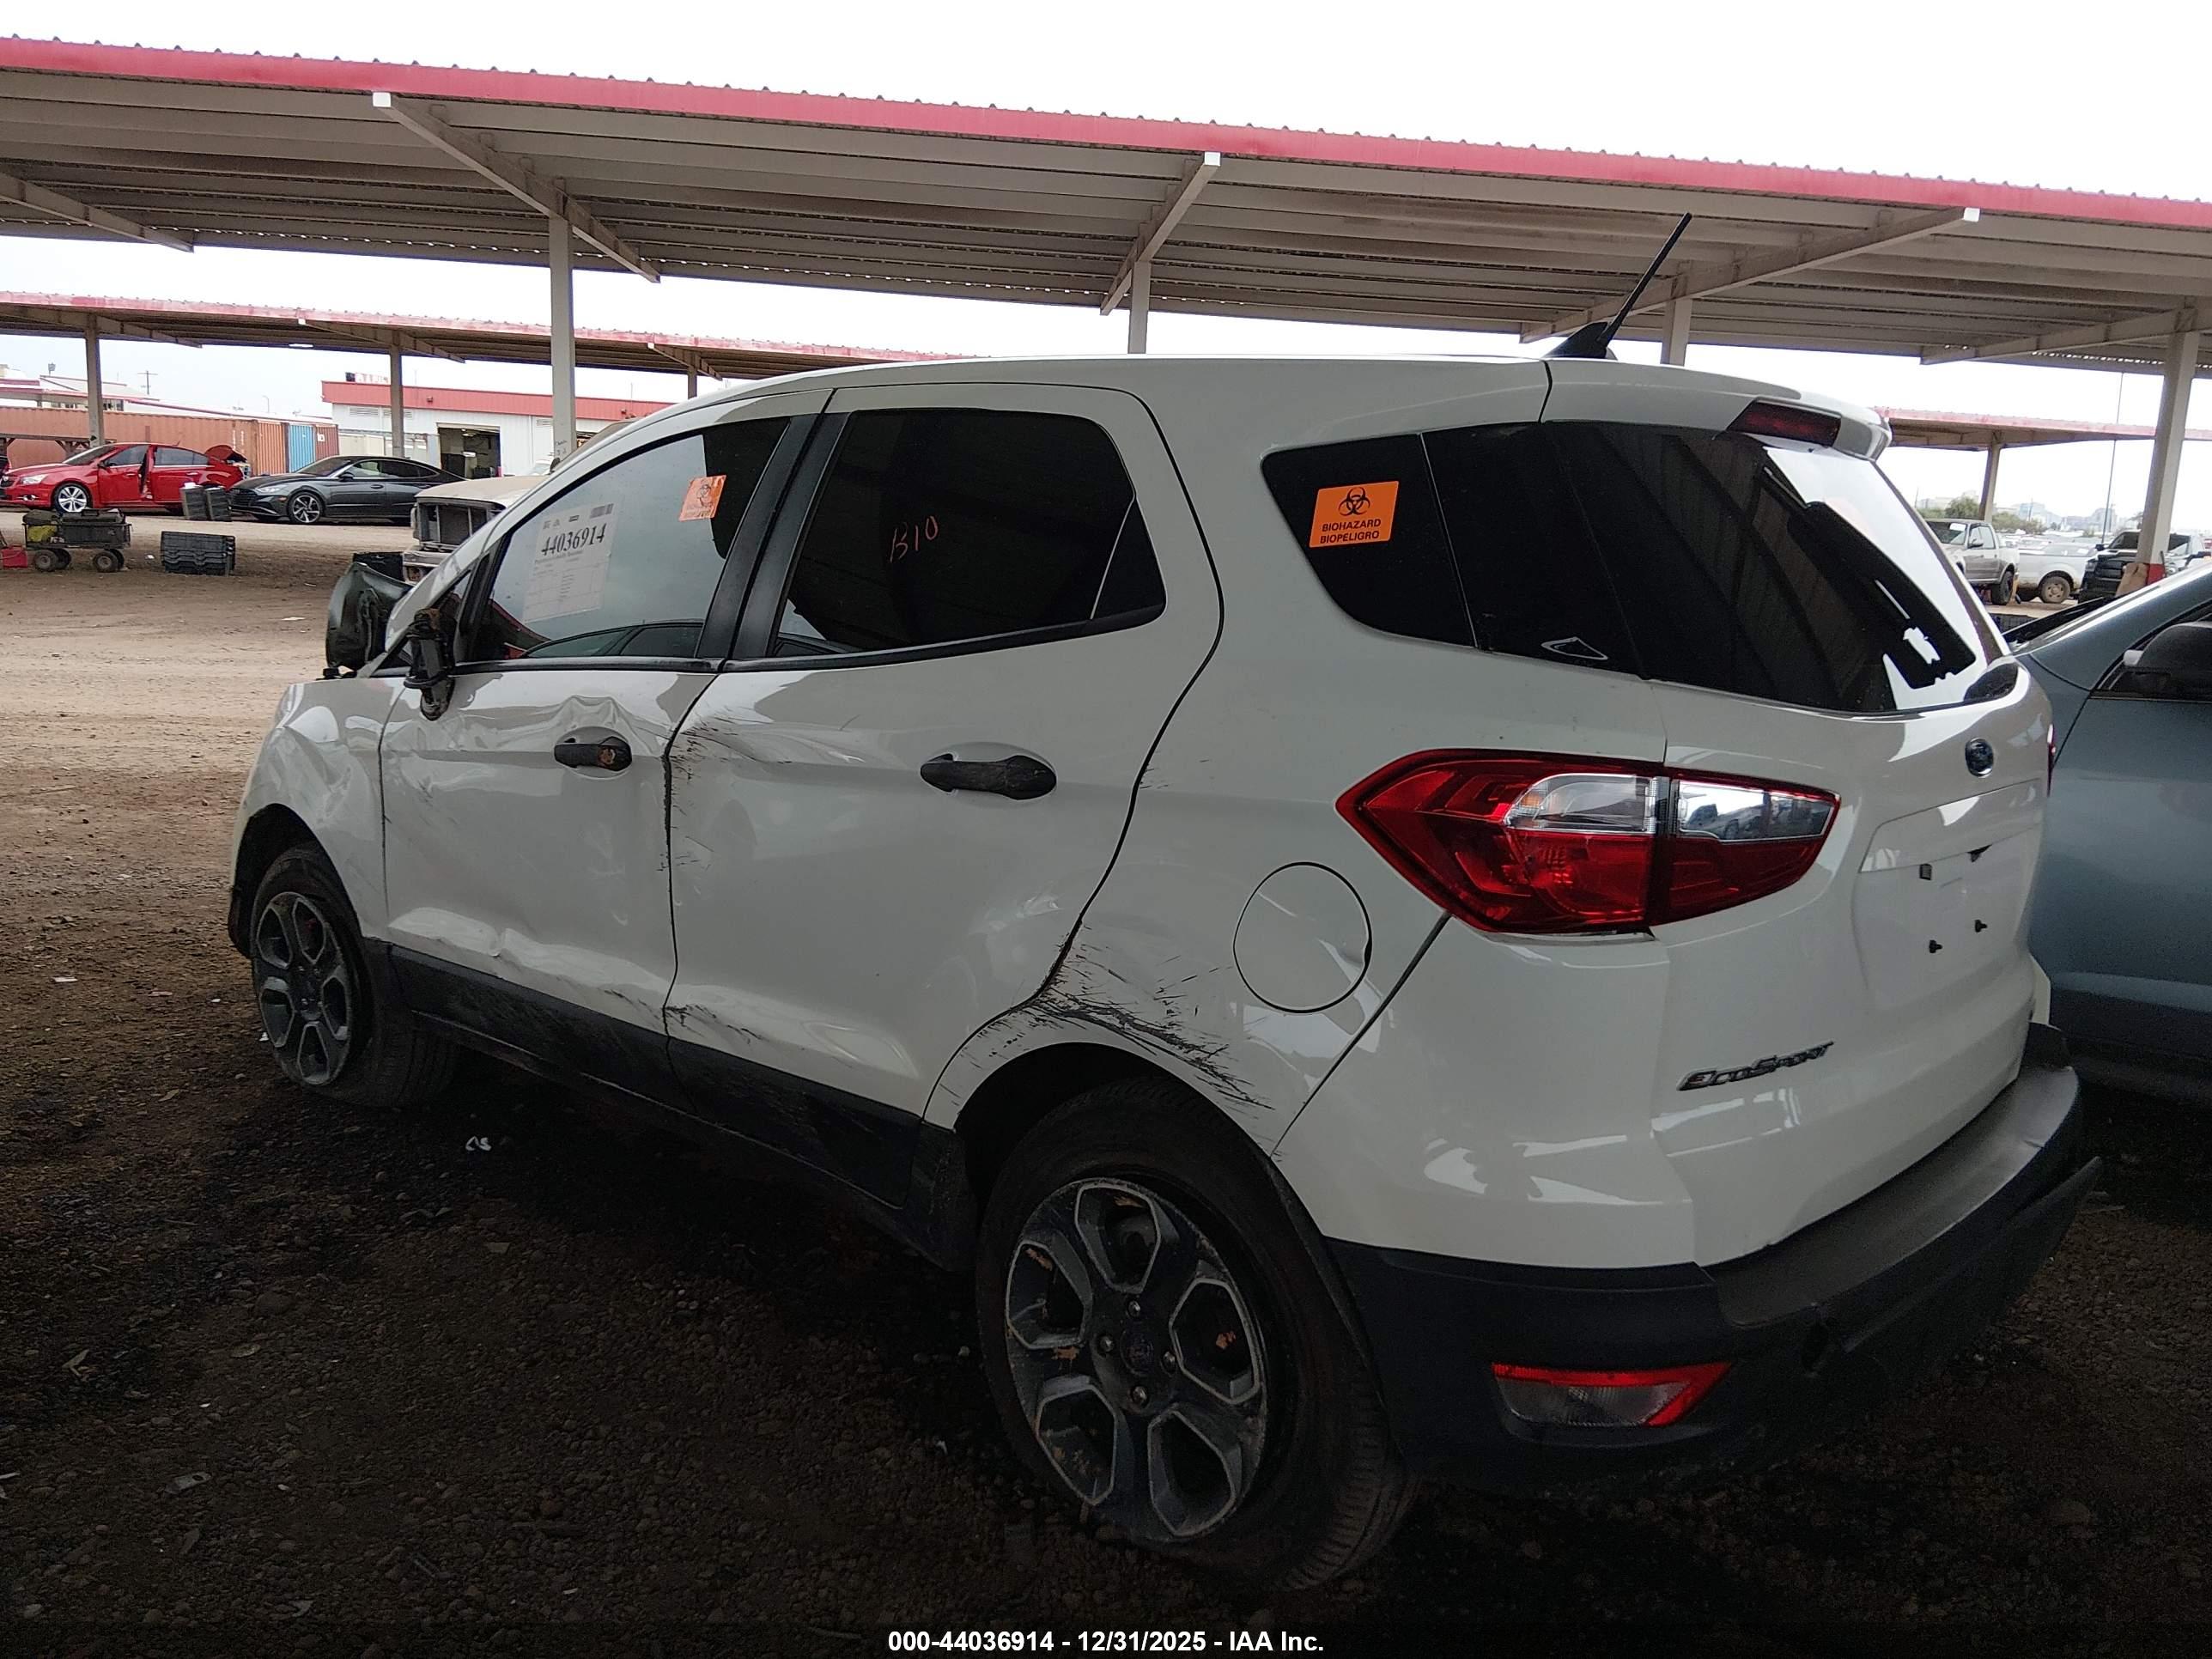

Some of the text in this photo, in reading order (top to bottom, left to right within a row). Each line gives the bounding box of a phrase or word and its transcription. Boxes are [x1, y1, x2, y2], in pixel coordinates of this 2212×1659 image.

[1322, 519, 1382, 532] BIOHAZARD
[541, 523, 607, 556] 44036914
[1320, 531, 1380, 544] BIOPELIGRO
